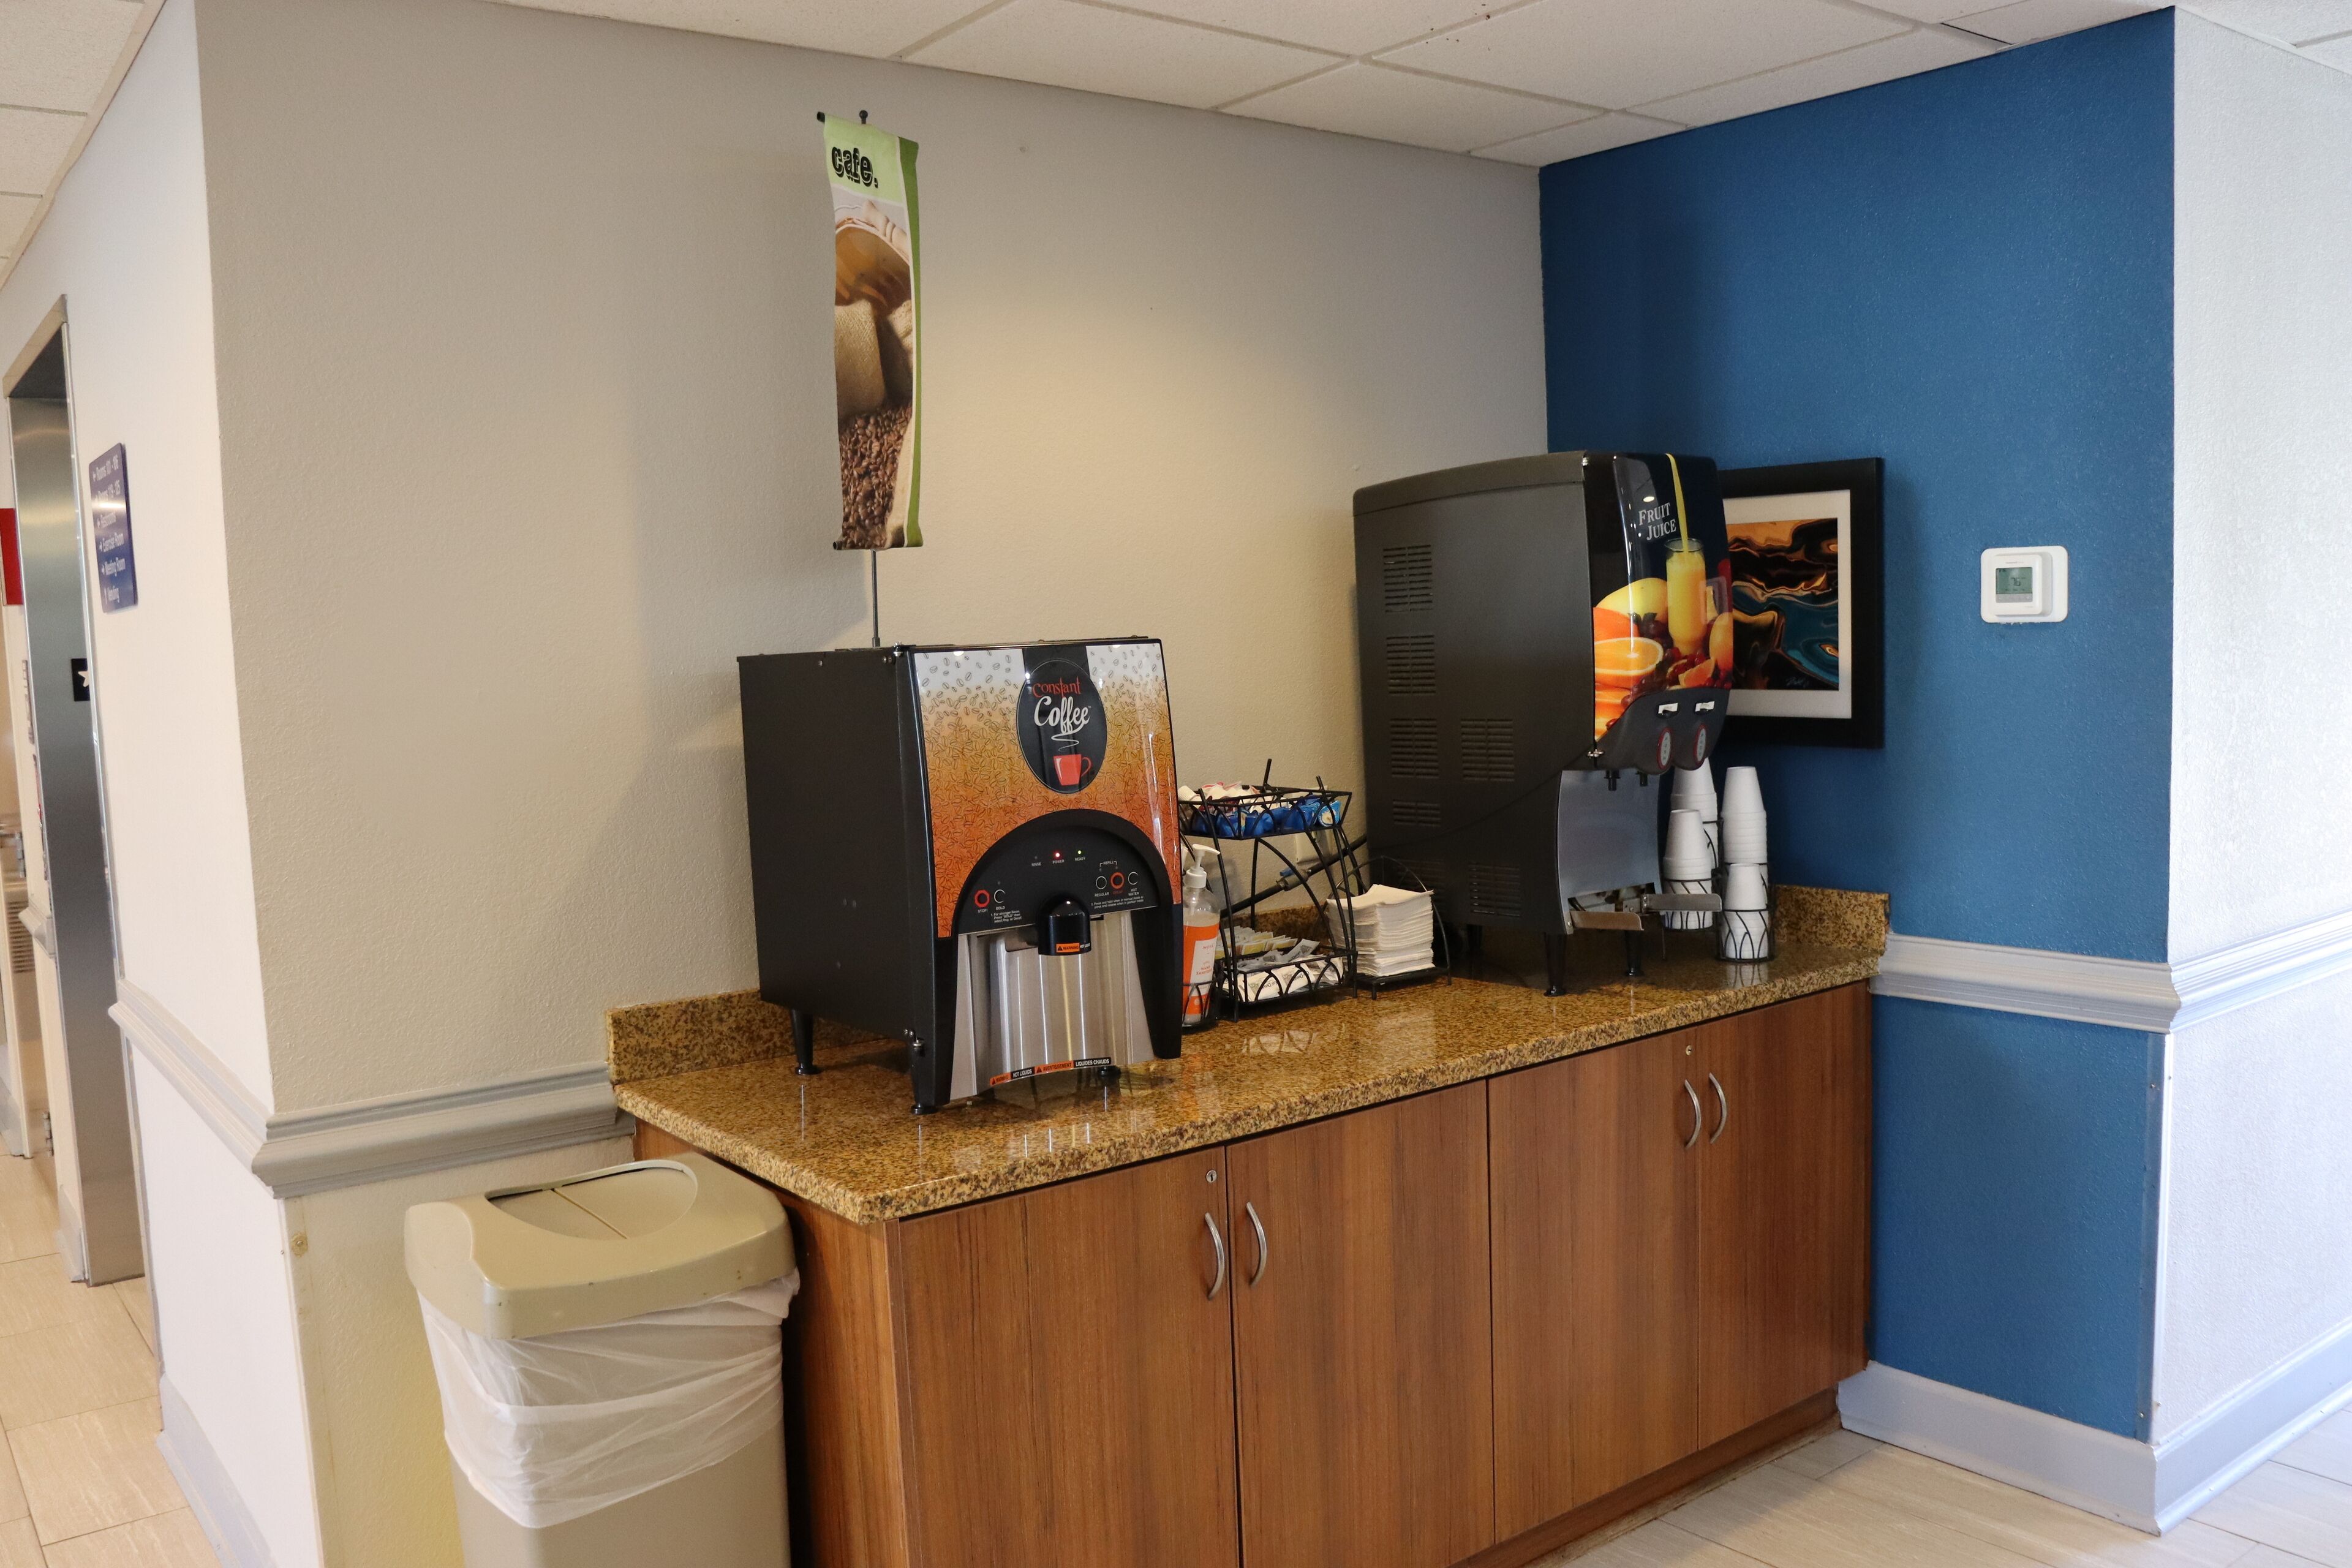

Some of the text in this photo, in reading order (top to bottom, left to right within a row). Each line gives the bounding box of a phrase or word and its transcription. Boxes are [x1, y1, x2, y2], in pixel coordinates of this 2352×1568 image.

[1638, 502, 1670, 526] FRUIT
[1646, 519, 1676, 540] JUICE
[102, 532, 124, 552] Exercise Room
[105, 556, 126, 577] Meeting Room
[107, 585, 120, 603] Vending
[1033, 676, 1081, 698] constant
[1034, 696, 1090, 734] Coffee
[1043, 1062, 1072, 1071] AVERTISSEMENT
